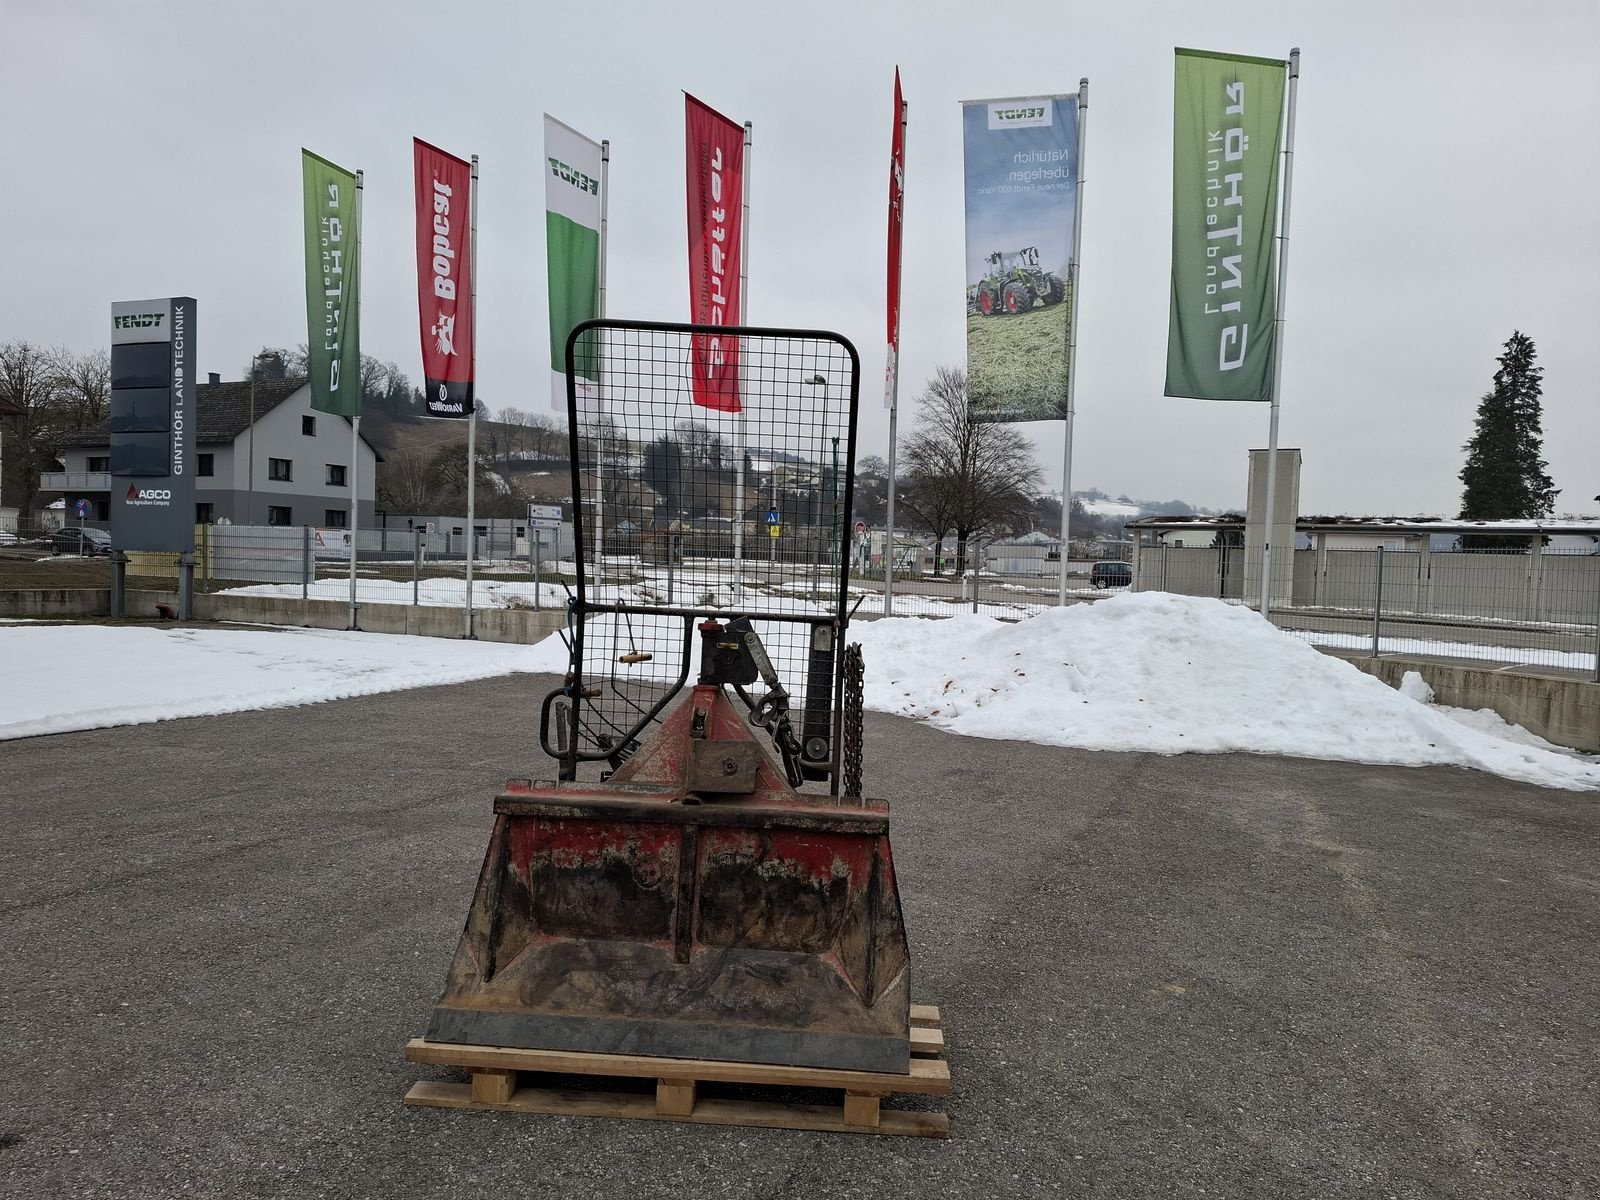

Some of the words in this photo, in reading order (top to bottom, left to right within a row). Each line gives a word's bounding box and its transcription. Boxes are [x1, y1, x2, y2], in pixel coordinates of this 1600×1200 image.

[114, 313, 165, 329] FENDT
[174, 305, 184, 406] LANDTECHNIK
[173, 409, 184, 475] GINTHÖR
[139, 489, 171, 499] AGCO
